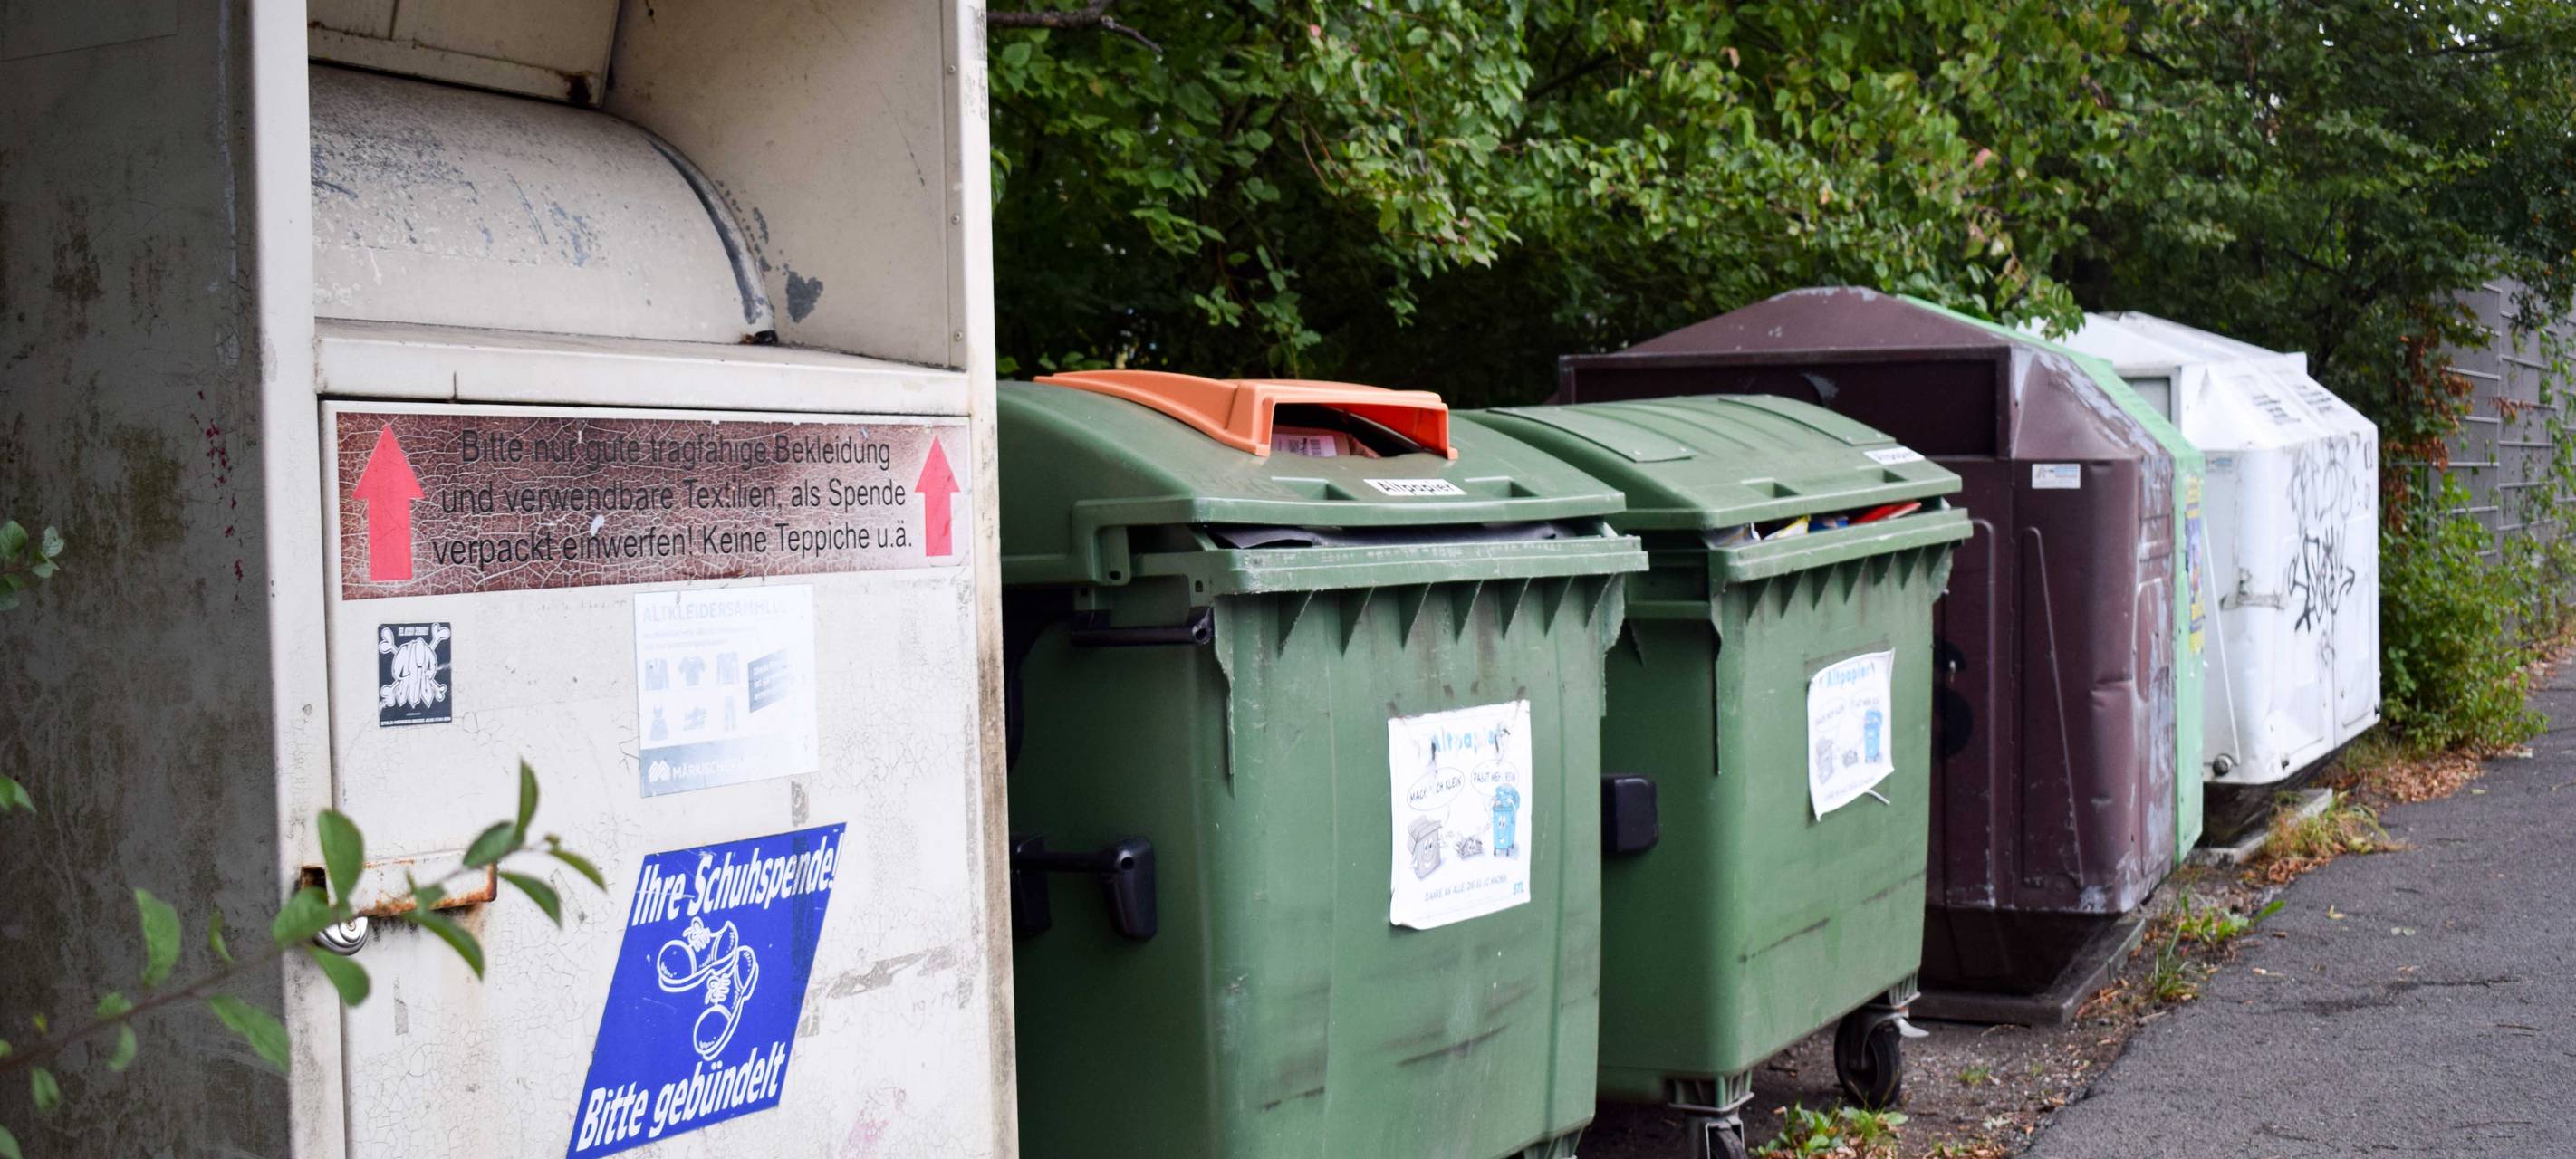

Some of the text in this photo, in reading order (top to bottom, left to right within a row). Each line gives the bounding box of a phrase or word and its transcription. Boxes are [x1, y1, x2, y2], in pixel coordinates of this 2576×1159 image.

[462, 430, 889, 471] Bitte nur gute tragfähige Bekleidung
[442, 478, 906, 513] und verwendbare Textilien, als Spende
[1378, 480, 1455, 495] Altpapier
[433, 521, 912, 571] verpackt einwerfen! Keine Teppiche u.ä.
[631, 864, 687, 927] Ihre
[576, 1041, 787, 1152] Bitte gebündelt
